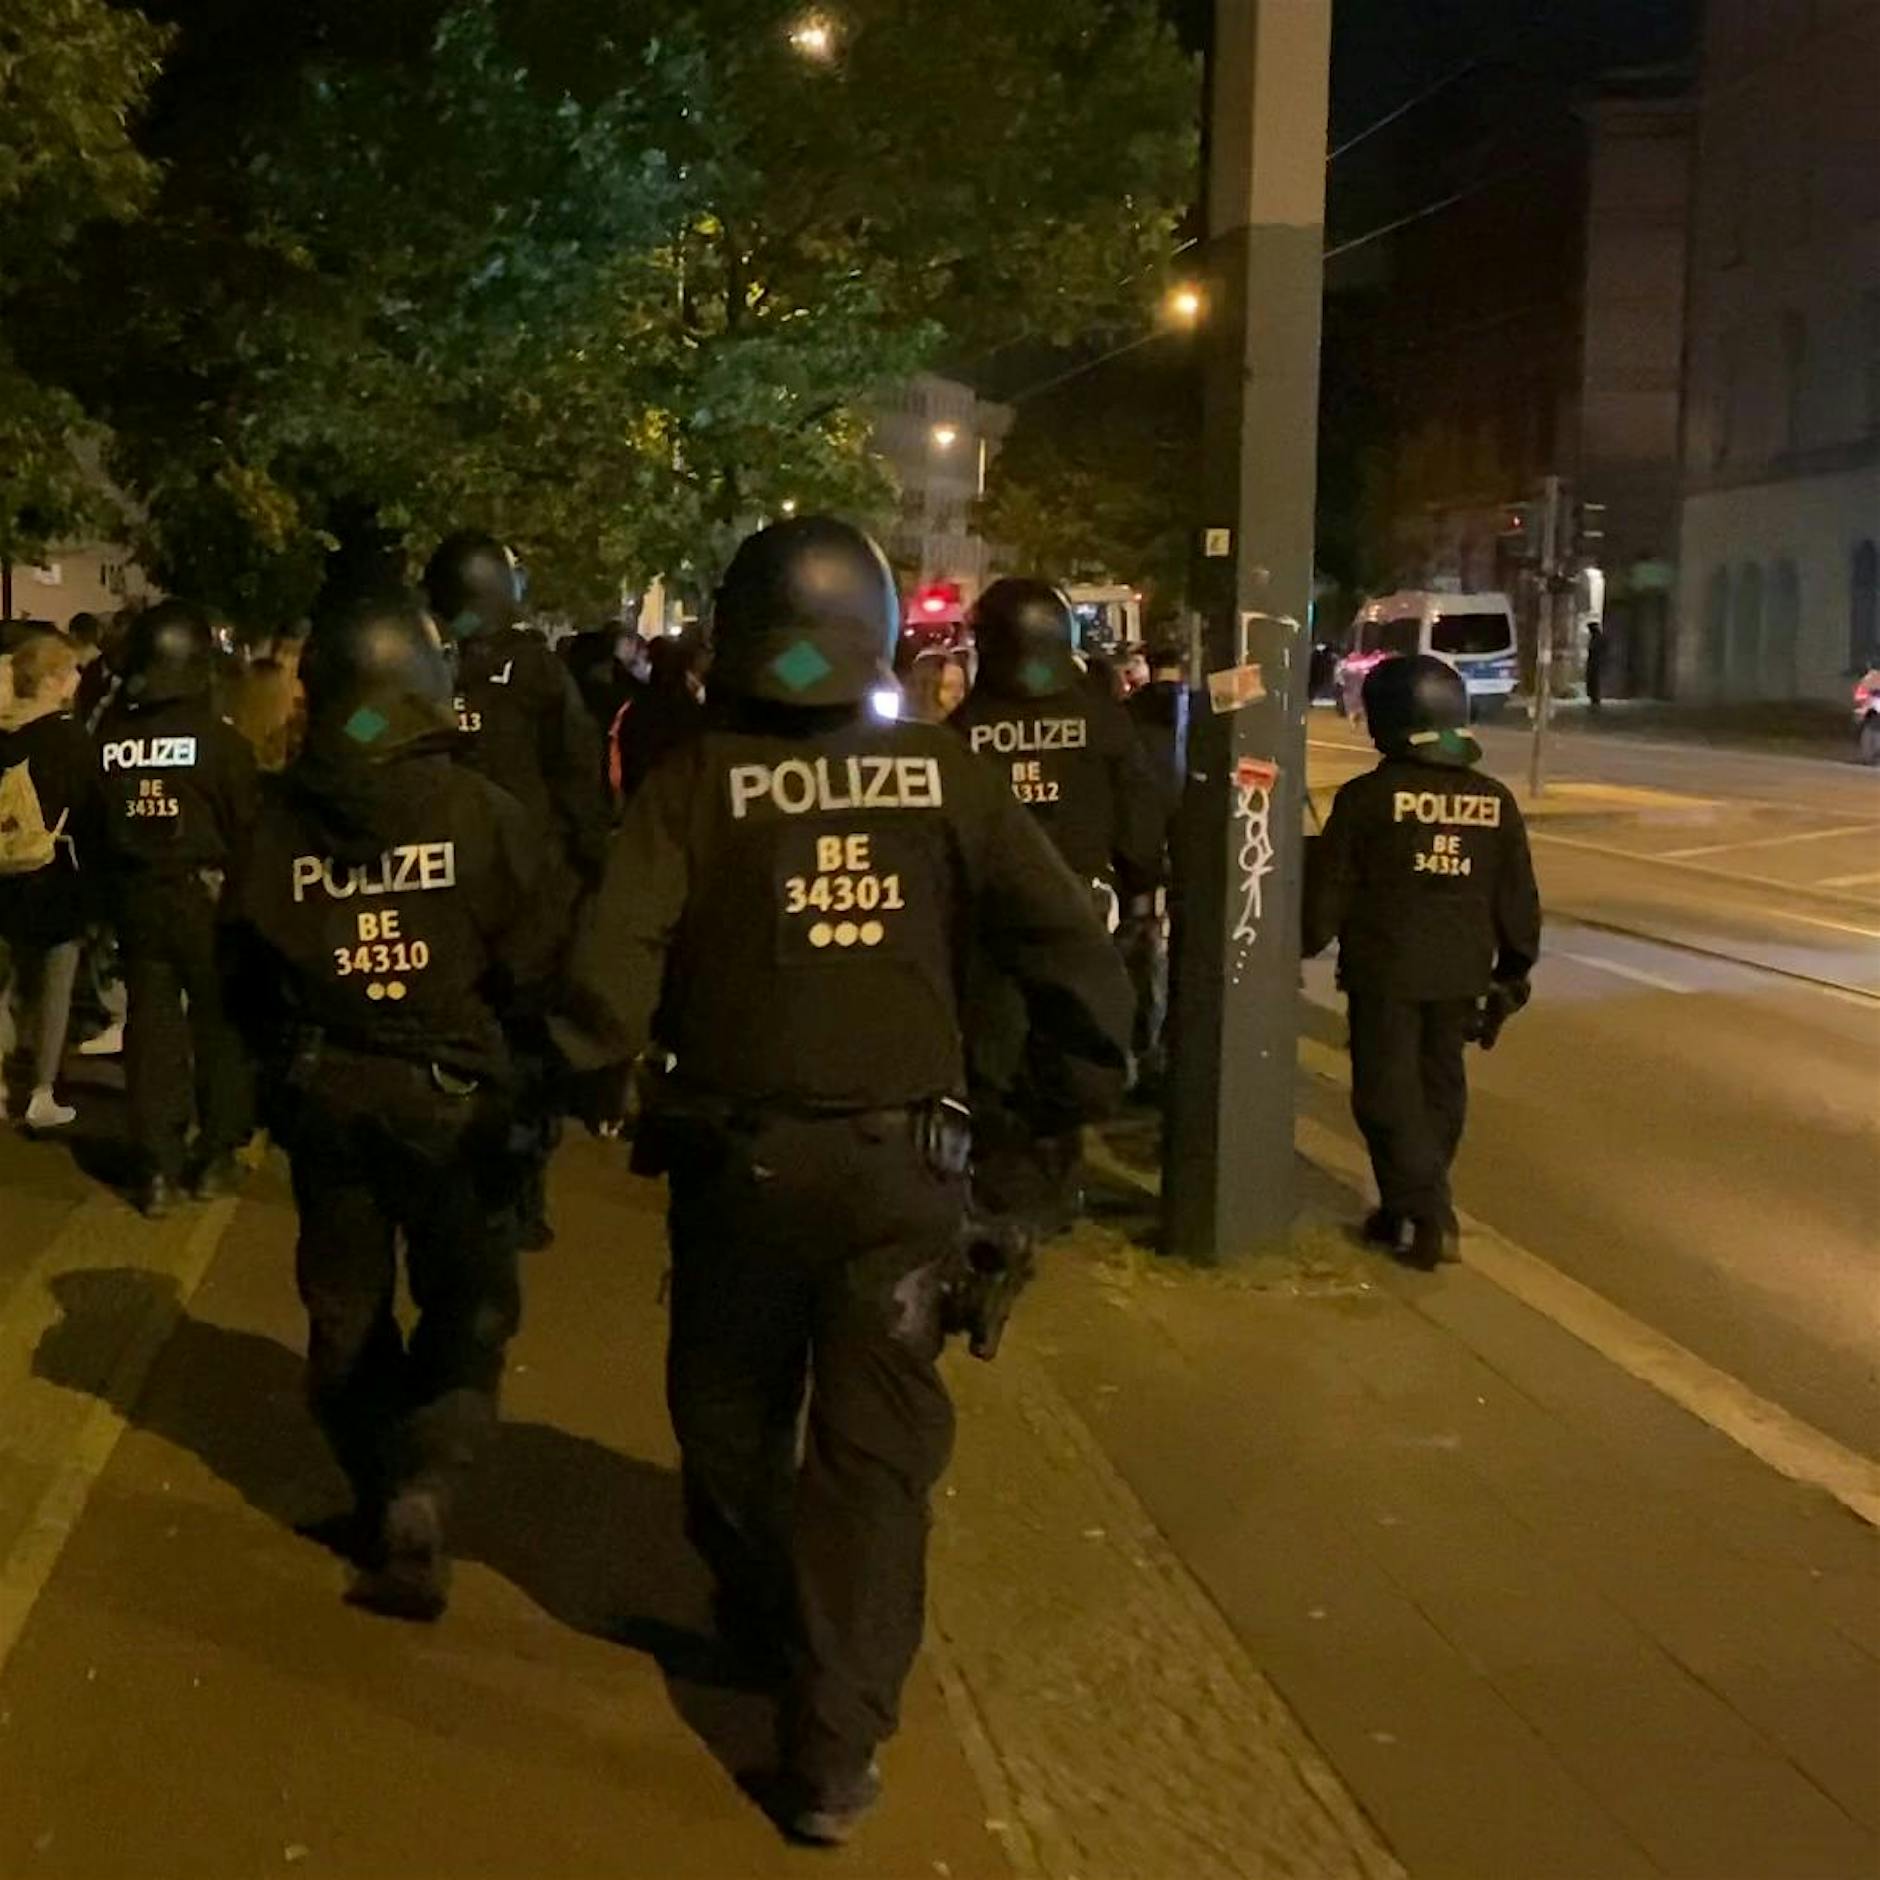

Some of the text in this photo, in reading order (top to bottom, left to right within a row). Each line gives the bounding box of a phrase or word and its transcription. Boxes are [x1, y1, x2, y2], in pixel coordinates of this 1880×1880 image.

[970, 718, 1086, 754] POLIZEI
[102, 737, 197, 772] POLIZEI
[1012, 761, 1041, 781] BE
[140, 779, 164, 797] BE
[729, 756, 943, 819] POLIZEI
[125, 798, 180, 818] 34315
[1394, 791, 1501, 828] POLIZEI
[817, 832, 872, 872] BE
[1433, 834, 1462, 855] BE
[293, 841, 456, 902] POLIZEI
[1413, 852, 1472, 876] 34314
[785, 874, 905, 914] 34301
[357, 910, 401, 941] BE
[333, 940, 429, 976] 34310
